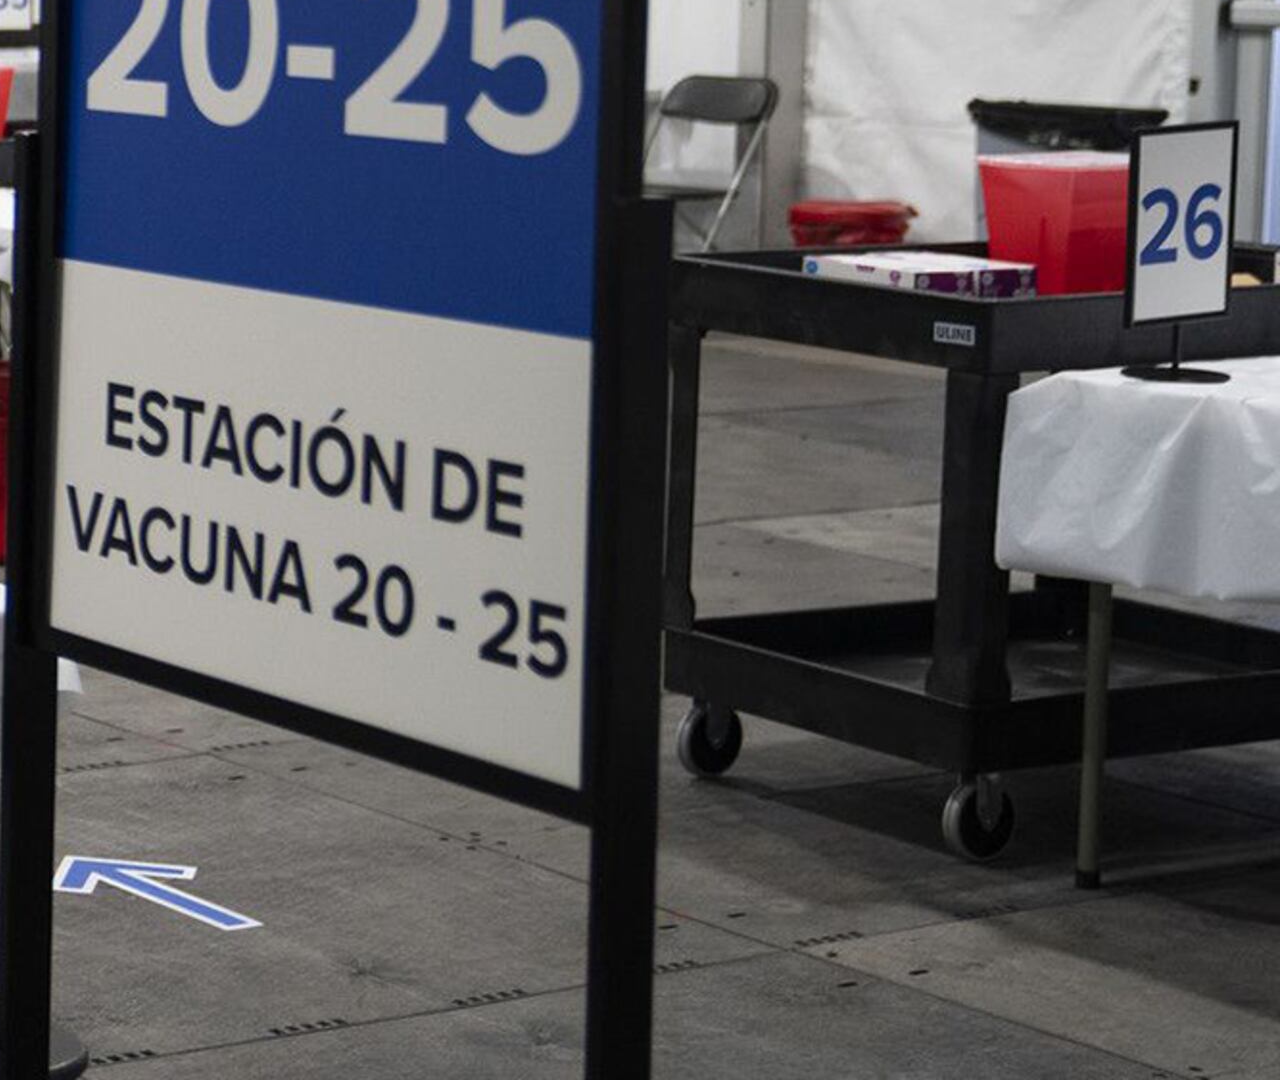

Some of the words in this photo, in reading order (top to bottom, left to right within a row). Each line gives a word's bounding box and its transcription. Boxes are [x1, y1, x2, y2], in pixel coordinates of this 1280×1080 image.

[1139, 183, 1224, 266] 26
[104, 381, 406, 513] ESTACIÓN
[431, 447, 526, 539] DE
[66, 483, 313, 614] VACUNA
[331, 552, 416, 638] 20
[478, 588, 570, 680] 25
